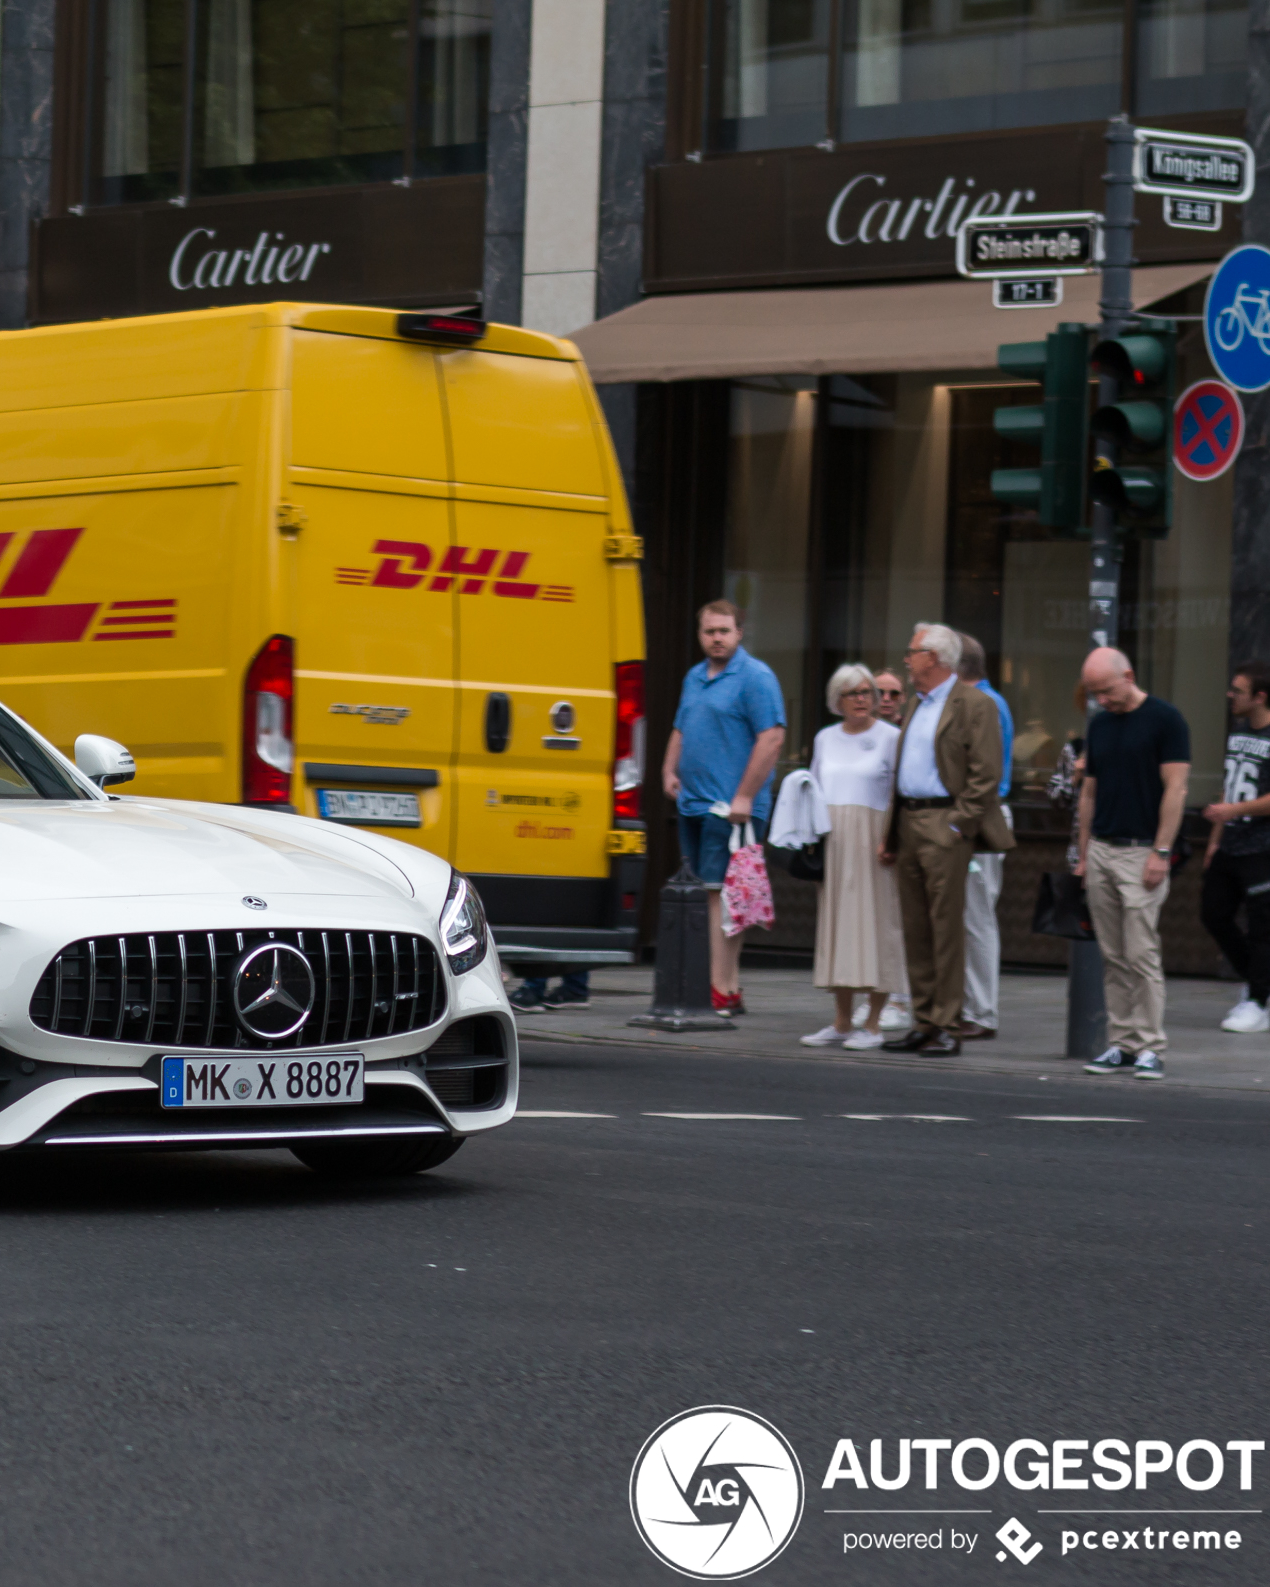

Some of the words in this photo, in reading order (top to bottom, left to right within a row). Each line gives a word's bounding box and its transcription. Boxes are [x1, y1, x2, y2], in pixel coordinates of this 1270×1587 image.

[1152, 149, 1240, 182] Königsallee
[169, 228, 331, 290] Cartier
[976, 231, 1082, 260] Steinstraße
[369, 539, 540, 601] DHL
[169, 1087, 178, 1098] D
[186, 1063, 231, 1100] MK
[256, 1062, 276, 1100] X
[286, 1060, 360, 1099] 8887
